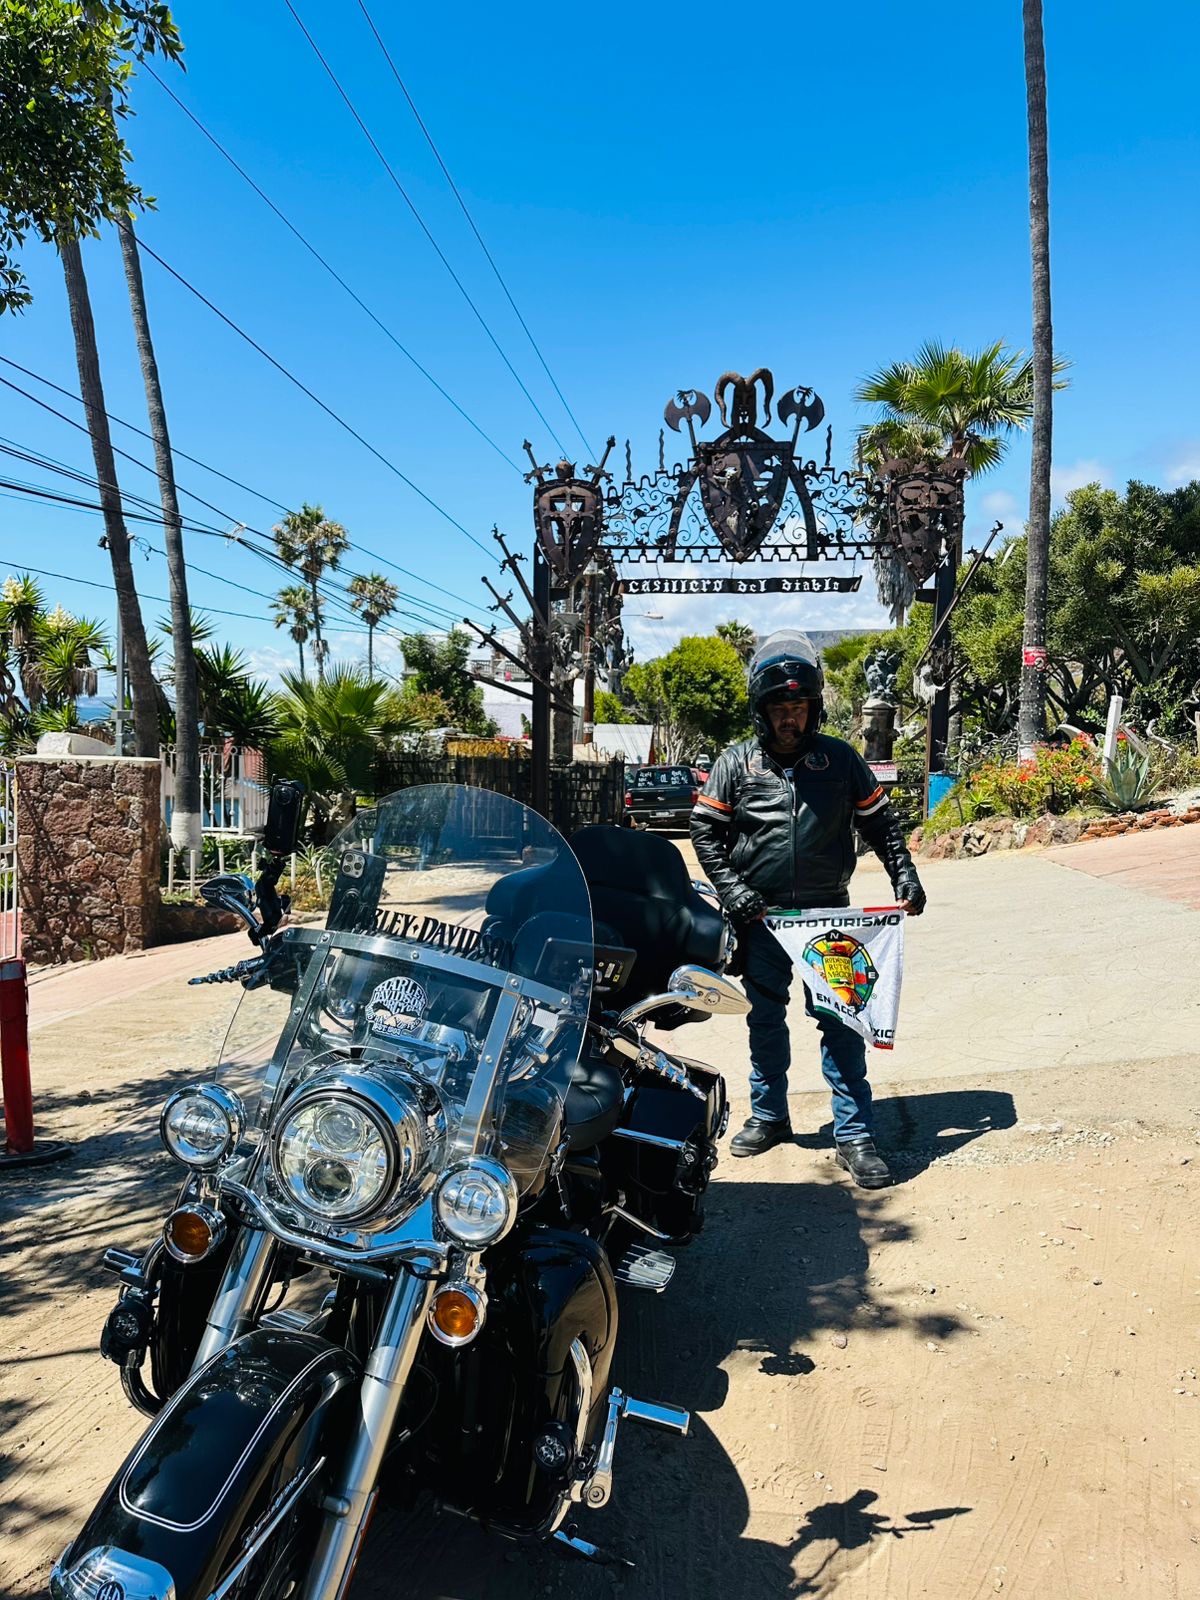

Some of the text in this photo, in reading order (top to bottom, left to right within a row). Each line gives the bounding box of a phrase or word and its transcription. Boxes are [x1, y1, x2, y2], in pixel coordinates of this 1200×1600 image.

[737, 579, 767, 592] del
[781, 578, 839, 592] diablo
[767, 914, 900, 931] MOTOTURISMO
[816, 993, 831, 1005] EN
